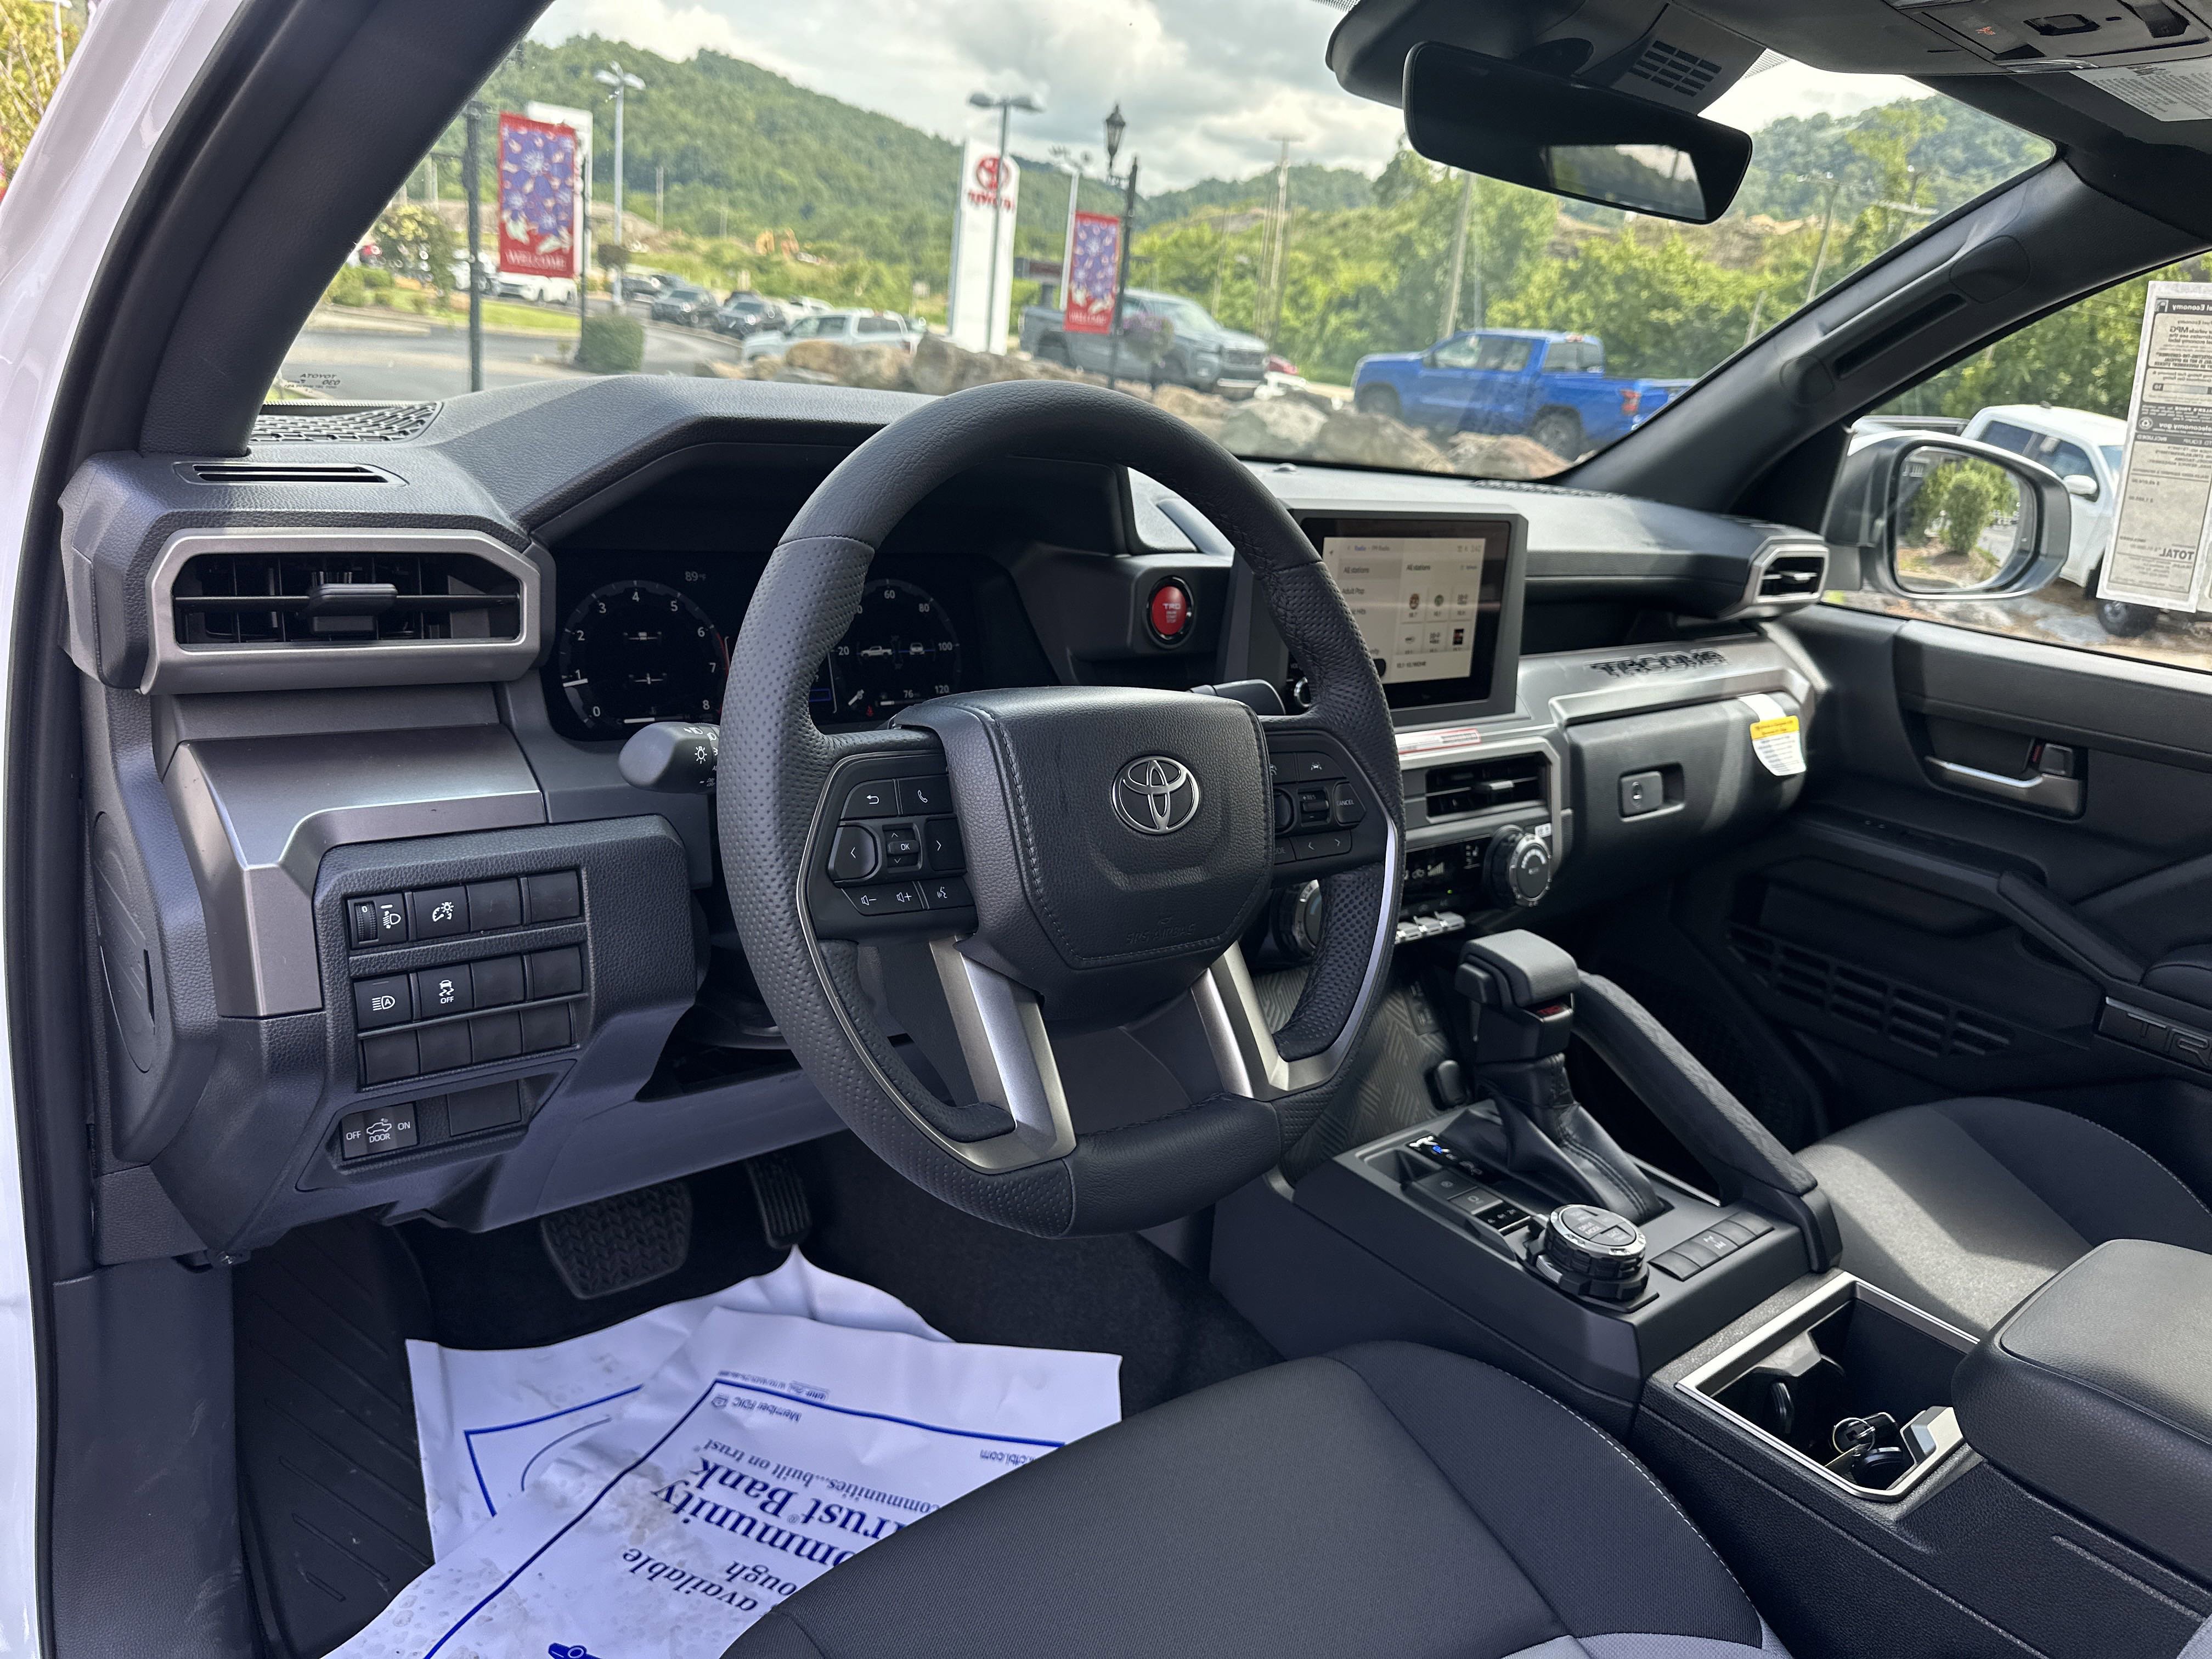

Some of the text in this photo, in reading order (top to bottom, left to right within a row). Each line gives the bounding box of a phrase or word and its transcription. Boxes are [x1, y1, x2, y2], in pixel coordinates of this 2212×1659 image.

[632, 592, 640, 602] 4
[884, 590, 896, 599] 60
[599, 603, 607, 613] 3
[670, 601, 678, 612] 5
[919, 603, 930, 613] 80
[577, 630, 585, 641] 2
[697, 627, 705, 637] 6
[838, 646, 850, 656] 20
[938, 642, 953, 651] 100
[1587, 648, 1728, 677] TACOMA
[709, 663, 716, 673] 7
[575, 670, 581, 680] 1
[903, 690, 914, 698] 76
[934, 685, 950, 694] 120
[702, 700, 710, 710] 8
[592, 707, 601, 717] 0
[440, 996, 454, 1004] OFF
[346, 1121, 410, 1143] OFF DOOR ON
[732, 1396, 802, 1423] Member FDIC
[750, 1455, 771, 1469] on
[690, 1457, 799, 1519] Bank
[653, 1479, 857, 1568] ommunity
[622, 1547, 759, 1613] available
